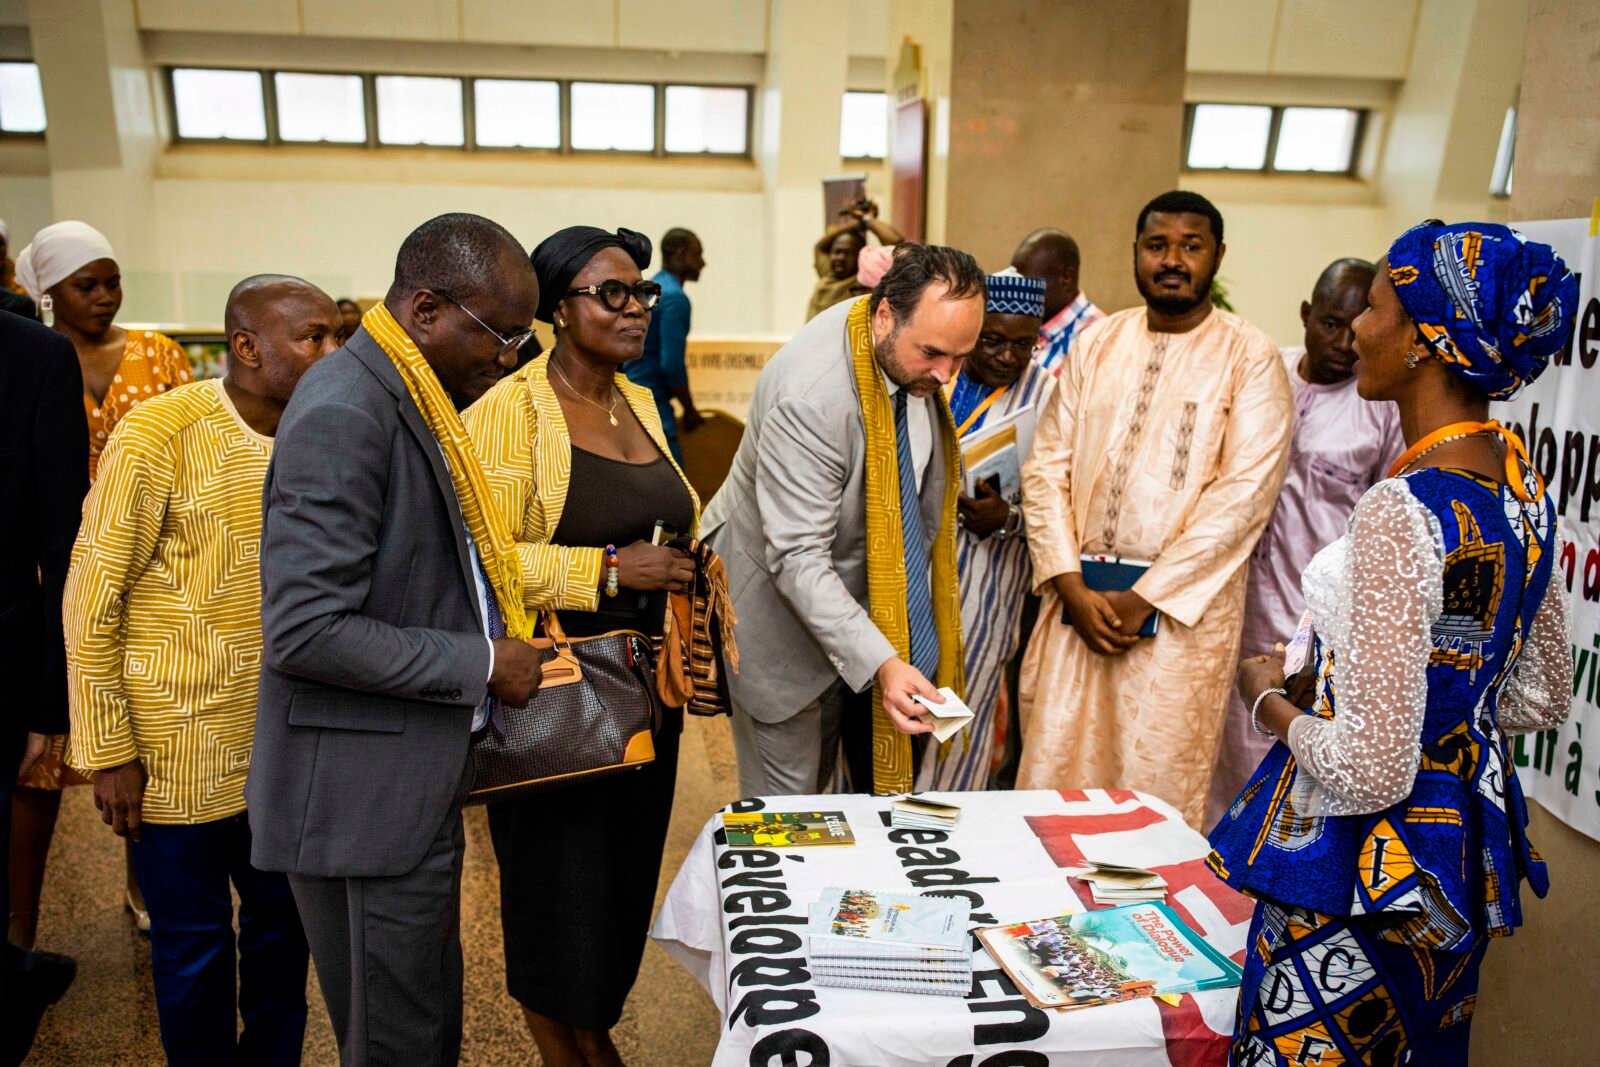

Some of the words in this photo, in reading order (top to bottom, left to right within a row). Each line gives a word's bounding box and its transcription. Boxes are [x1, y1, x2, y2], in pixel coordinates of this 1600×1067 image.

[1565, 721, 1582, 797] à
[823, 815, 846, 837] L'ÉLUE
[713, 827, 831, 1067] éveloppe
[1132, 913, 1149, 923] of
[1142, 924, 1185, 963] Dialogue
[1145, 910, 1164, 929] The
[1162, 929, 1195, 957] Power
[1264, 967, 1294, 1015] D
[1319, 947, 1355, 993] C
